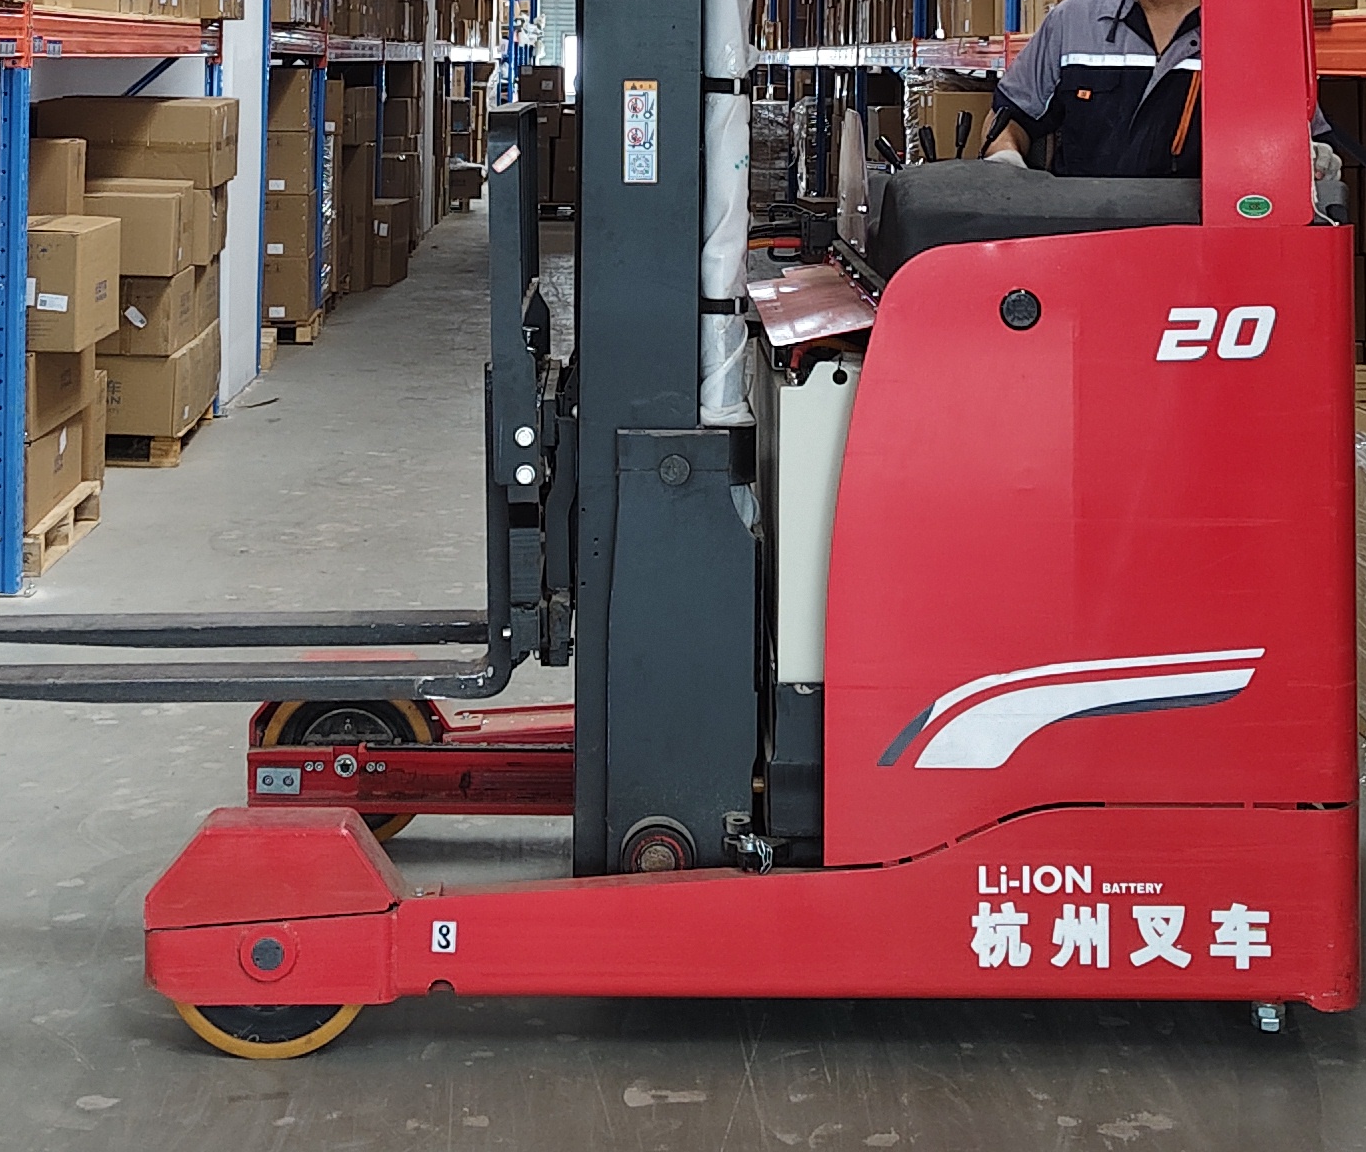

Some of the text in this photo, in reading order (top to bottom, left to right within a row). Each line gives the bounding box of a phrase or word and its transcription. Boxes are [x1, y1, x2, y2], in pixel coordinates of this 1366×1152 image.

[1156, 305, 1277, 362] 20
[977, 865, 1164, 895] Li-ION BATTERY
[970, 901, 1273, 970] 杭州叉车
